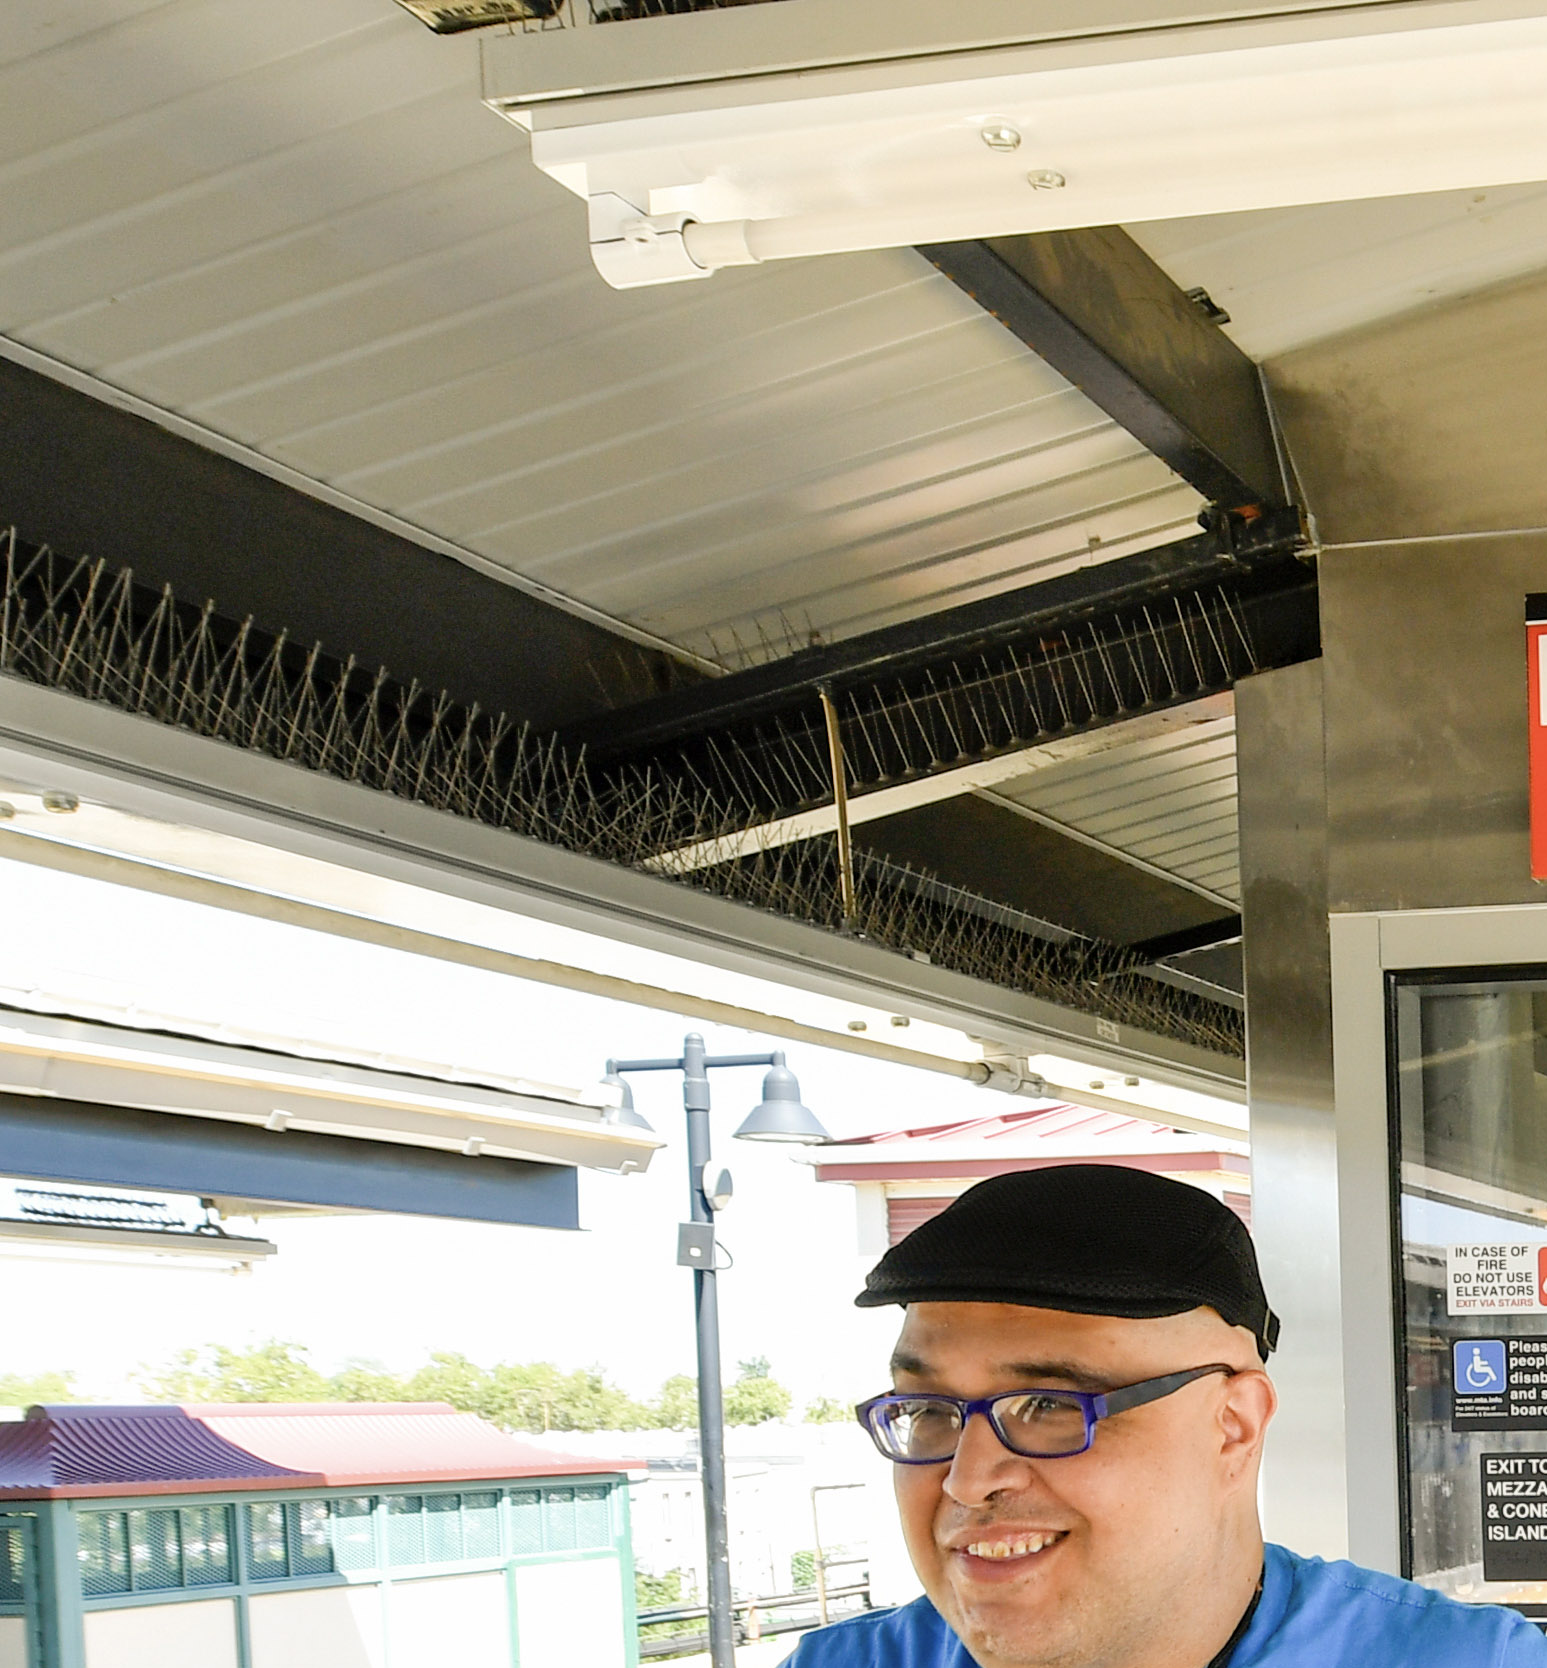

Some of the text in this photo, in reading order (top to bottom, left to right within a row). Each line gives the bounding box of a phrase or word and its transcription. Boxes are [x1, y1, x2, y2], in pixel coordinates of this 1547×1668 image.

[1455, 1246, 1529, 1258] IN CASE OF
[1477, 1259, 1507, 1270] FIRE
[1453, 1272, 1533, 1283] DO NOT USE
[1456, 1285, 1534, 1297] ELEVATORS
[1456, 1298, 1534, 1308] EXIT VIA STAIRS
[1510, 1387, 1537, 1400] and
[1486, 1459, 1525, 1474] EXIT
[1487, 1504, 1500, 1518] &
